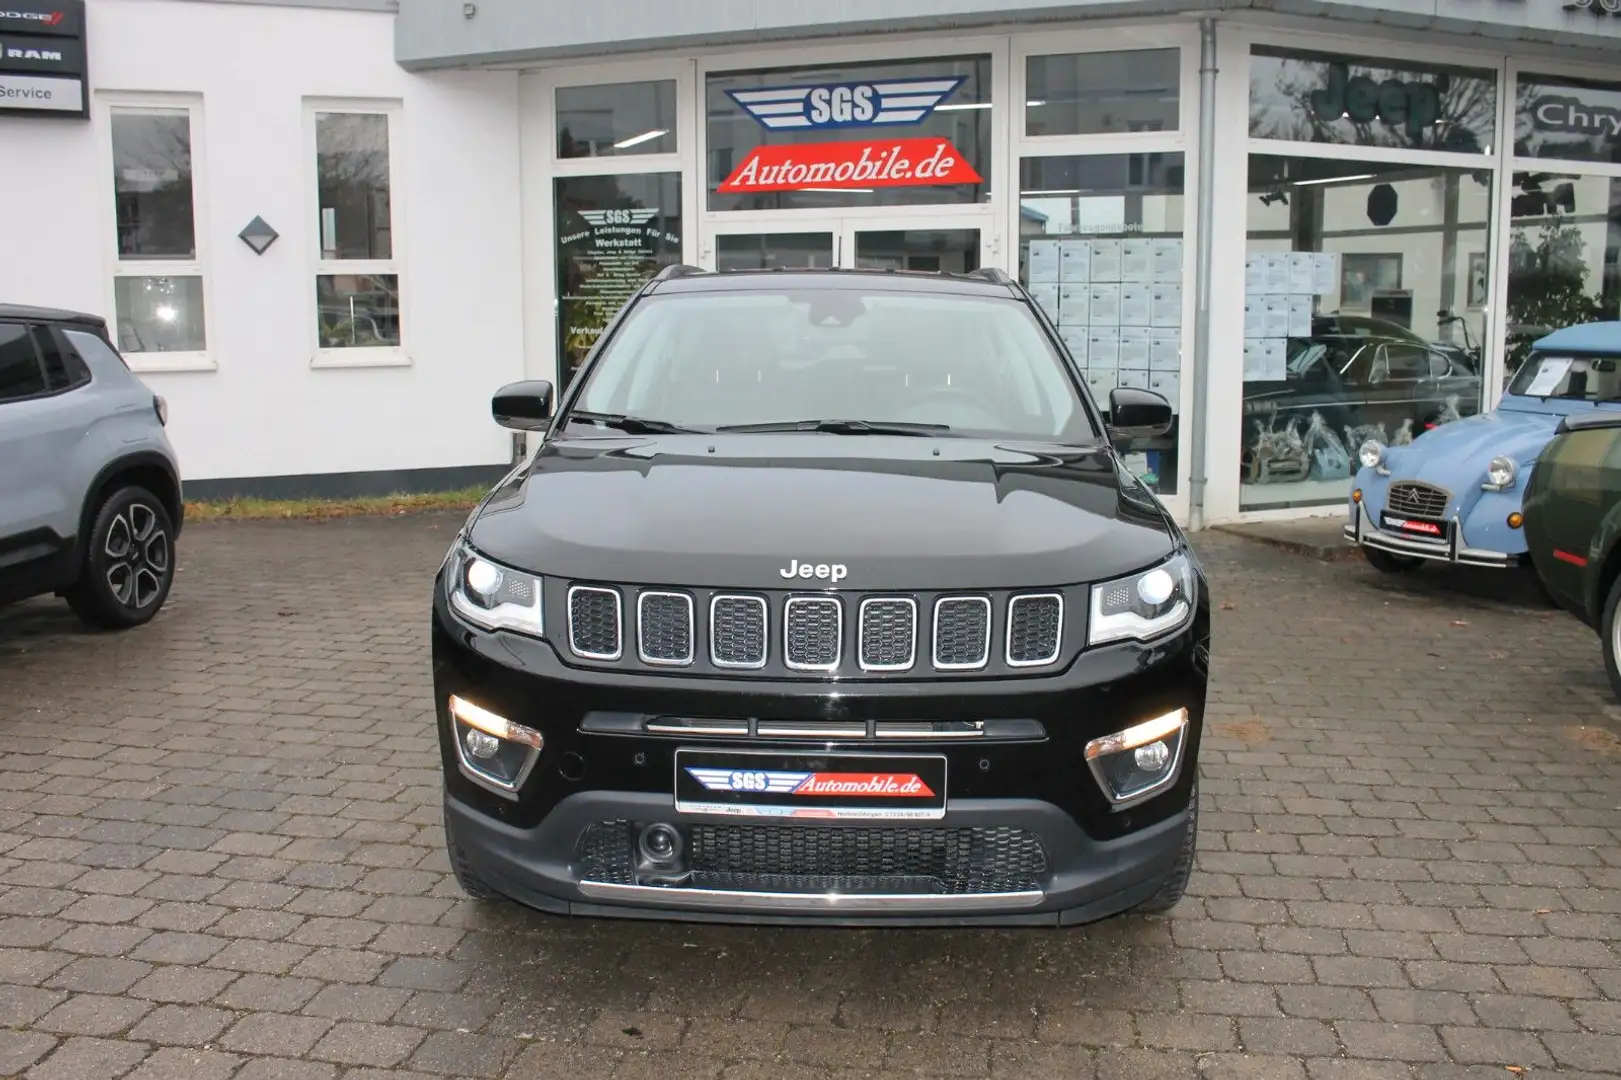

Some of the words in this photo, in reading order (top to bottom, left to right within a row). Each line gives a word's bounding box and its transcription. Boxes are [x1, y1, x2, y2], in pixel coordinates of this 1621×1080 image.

[7, 48, 62, 60] RAM
[0, 85, 52, 99] Service
[810, 85, 873, 124] SGS
[730, 144, 955, 187] Automobile.de
[606, 209, 631, 224] SGS
[560, 230, 590, 244] Unsere
[594, 226, 642, 236] Leistungen
[665, 232, 680, 244] Sie
[595, 238, 642, 247] Werkstatt
[780, 559, 847, 582] Jeep
[731, 772, 767, 790] SGS
[800, 776, 922, 793] Automobile.de
